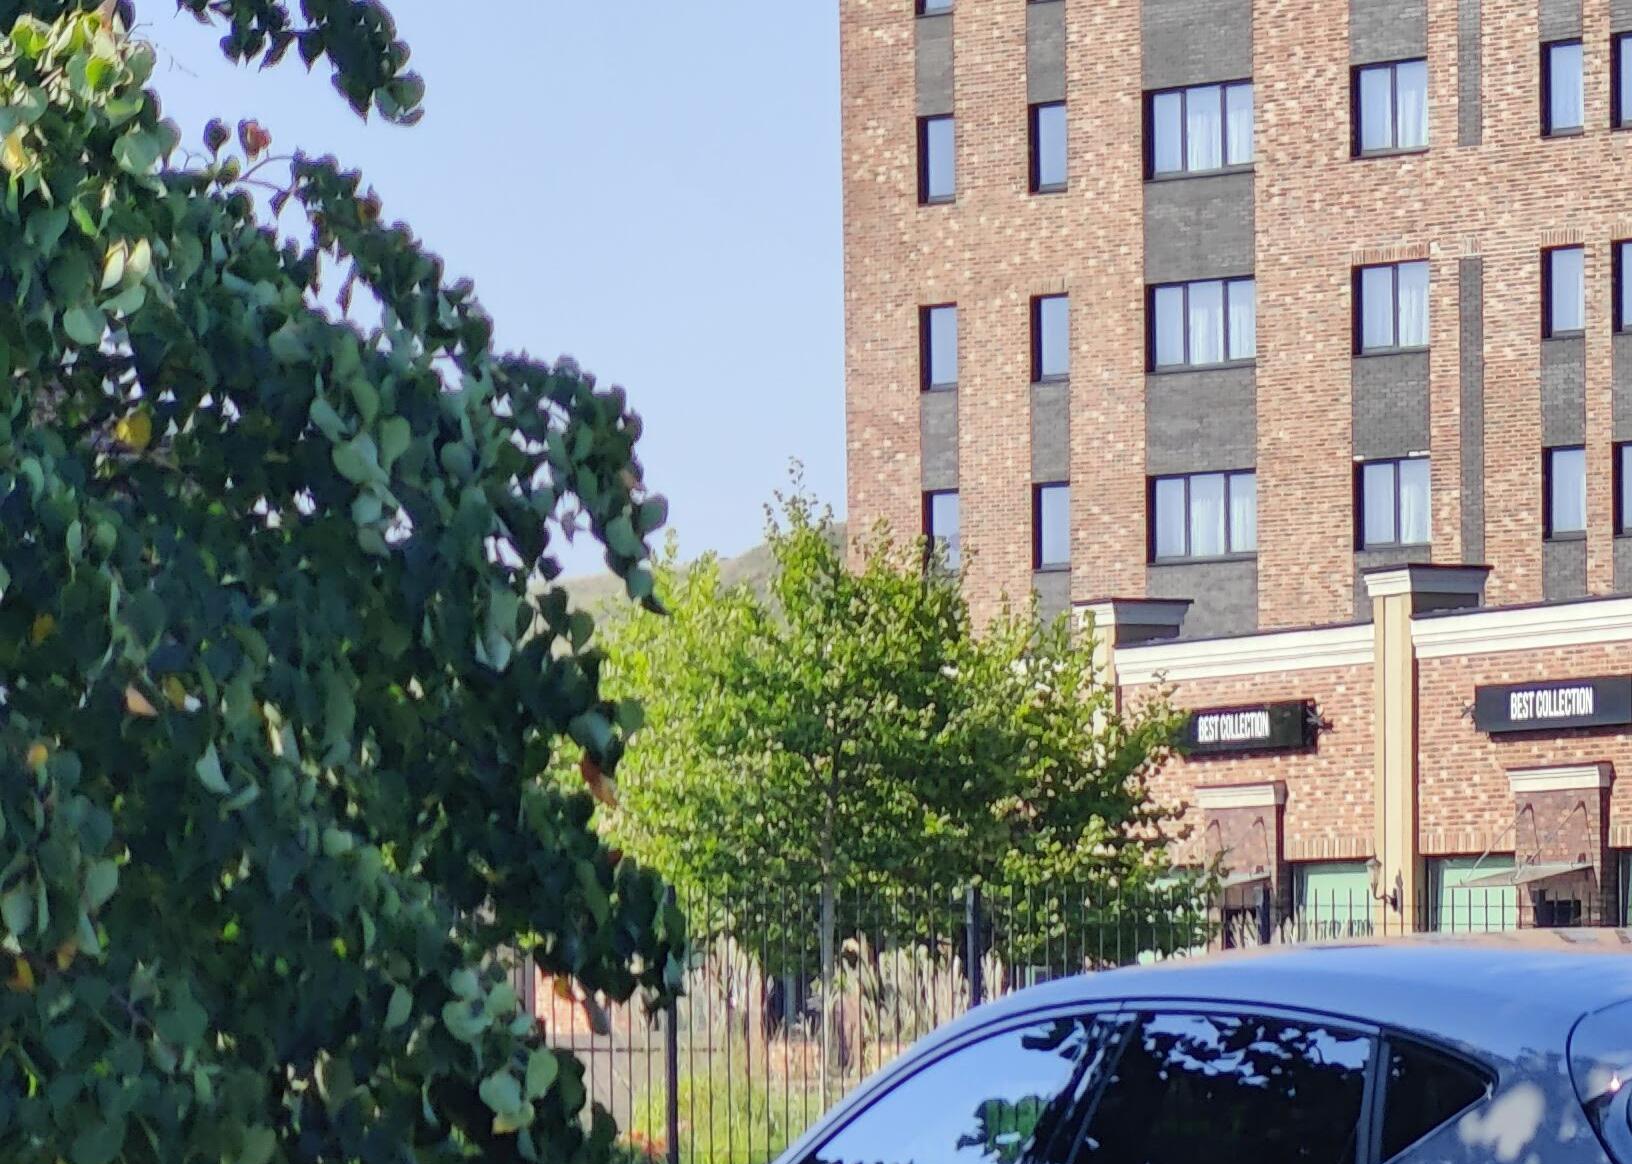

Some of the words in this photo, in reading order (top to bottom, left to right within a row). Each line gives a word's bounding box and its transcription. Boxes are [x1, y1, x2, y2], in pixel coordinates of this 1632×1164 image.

[1510, 691, 1535, 720] BEST
[1535, 686, 1594, 718] COLLECTION
[1197, 714, 1220, 743] BEST
[1220, 710, 1270, 740] COLLECTION
